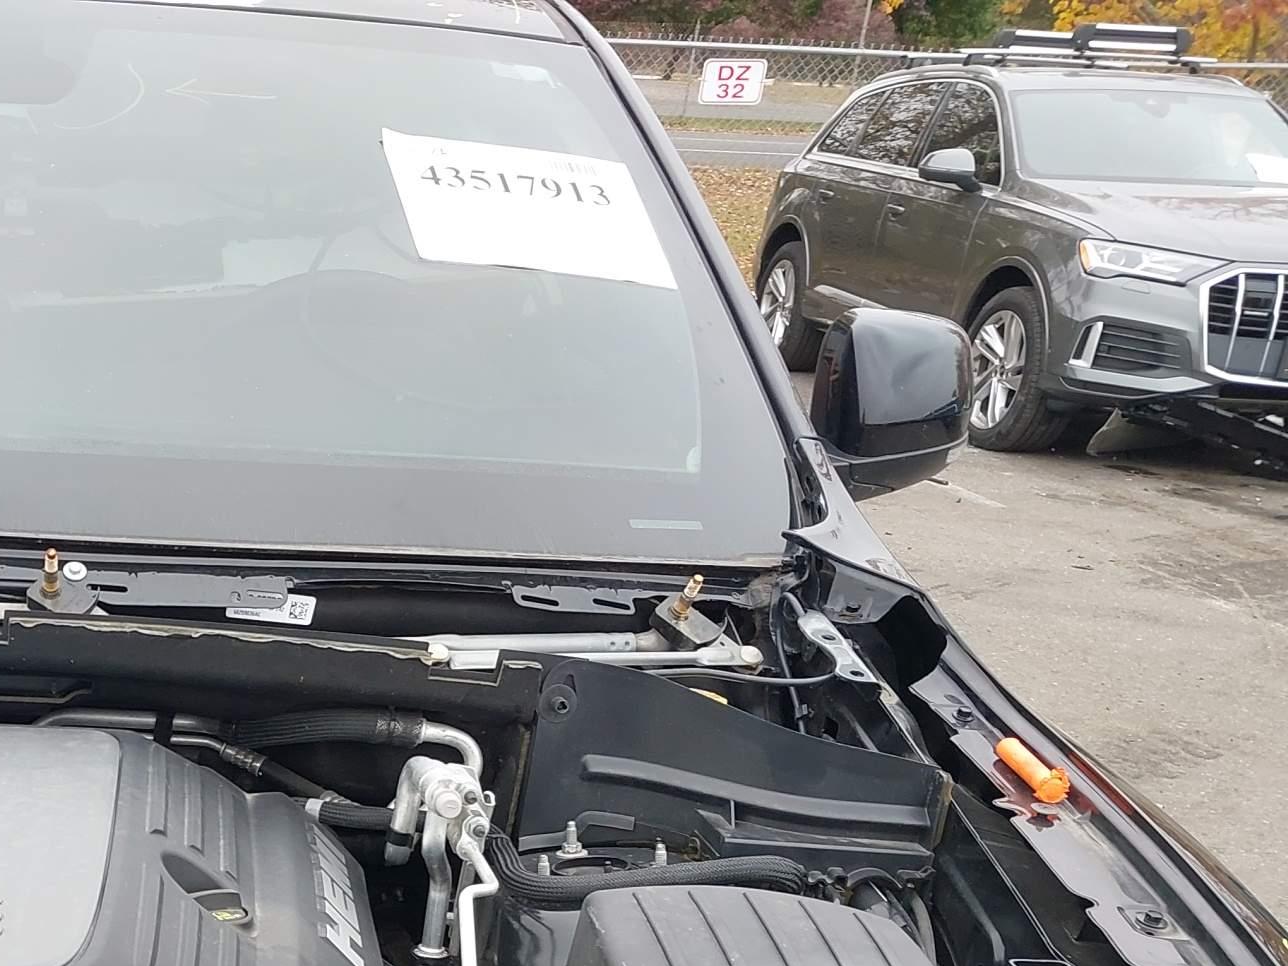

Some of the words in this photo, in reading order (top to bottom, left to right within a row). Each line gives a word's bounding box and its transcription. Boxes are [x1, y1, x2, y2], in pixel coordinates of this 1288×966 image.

[718, 65, 752, 81] DZ
[716, 83, 745, 99] 32
[420, 165, 611, 206] 43517913
